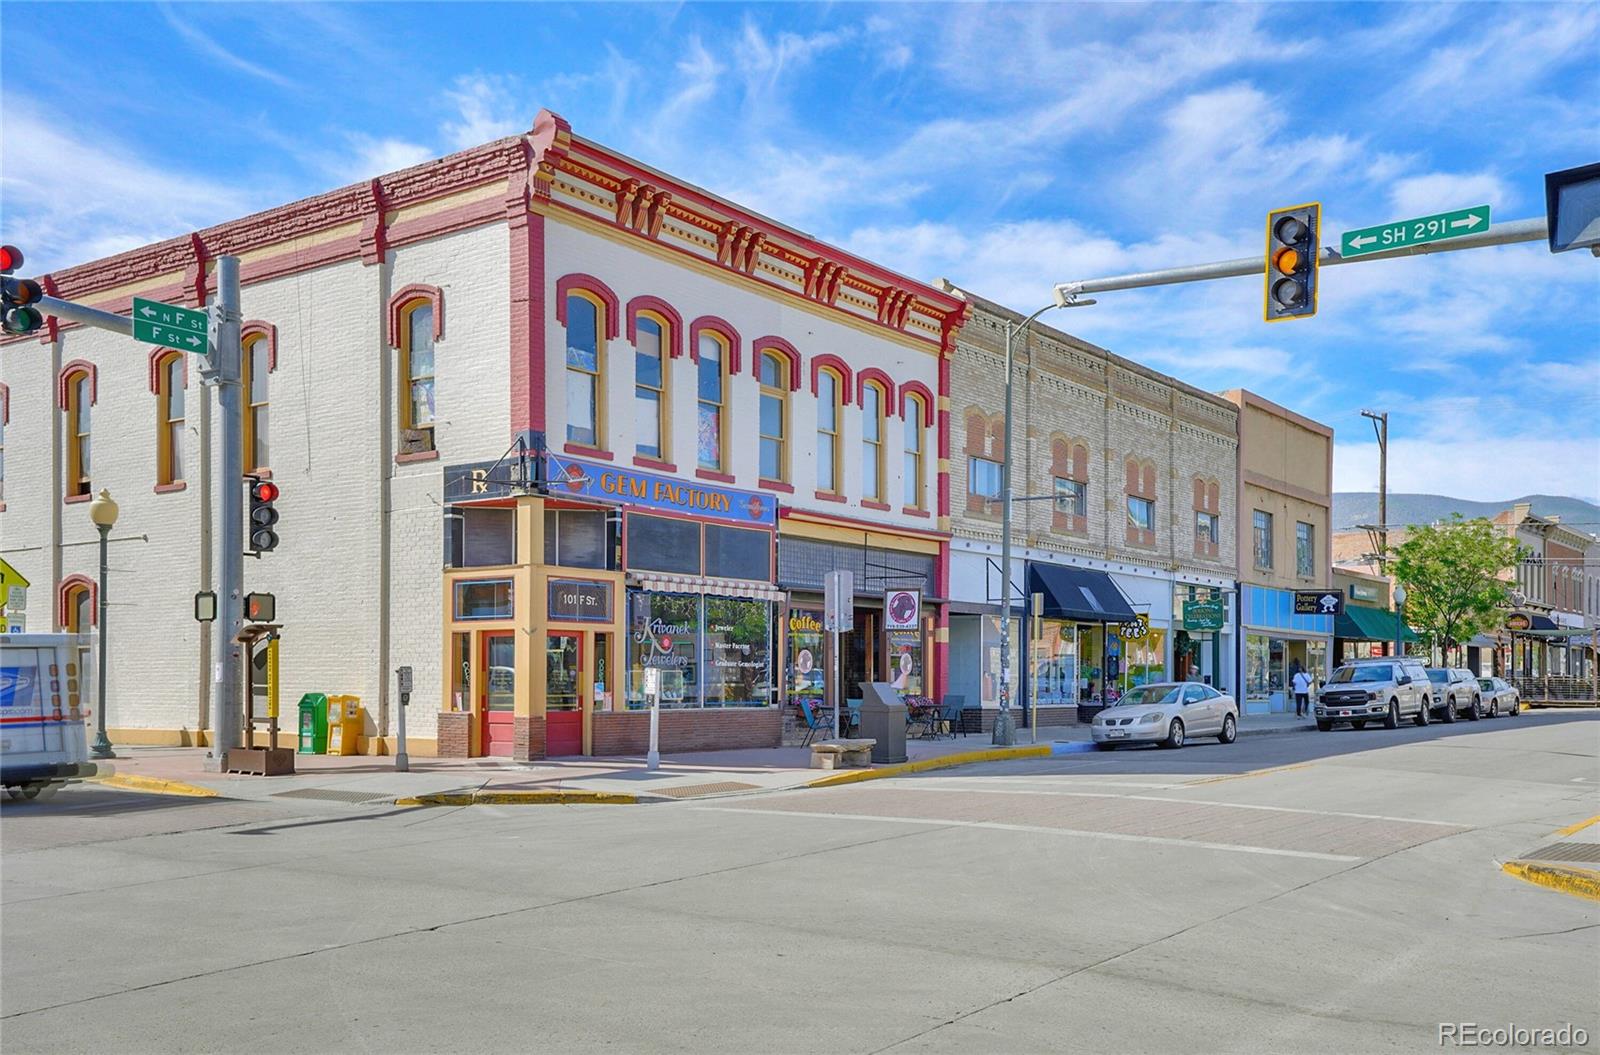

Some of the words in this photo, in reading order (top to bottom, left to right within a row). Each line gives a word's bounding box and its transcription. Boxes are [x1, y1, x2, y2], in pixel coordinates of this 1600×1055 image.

[1381, 226, 1406, 245] SH
[1414, 218, 1447, 239] 291
[163, 313, 170, 322] N
[175, 312, 185, 325] F
[191, 319, 203, 330] St
[152, 326, 162, 339] F
[168, 333, 180, 344] St
[600, 471, 648, 499] GEM
[653, 481, 734, 512] FACTORY
[563, 594, 577, 605] 101
[579, 595, 585, 605] F
[1296, 593, 1318, 603] Pottery
[1296, 603, 1318, 613] Gallery
[634, 616, 690, 644] Krivanek
[789, 616, 821, 632] Coffee
[640, 643, 689, 666] Jewelers
